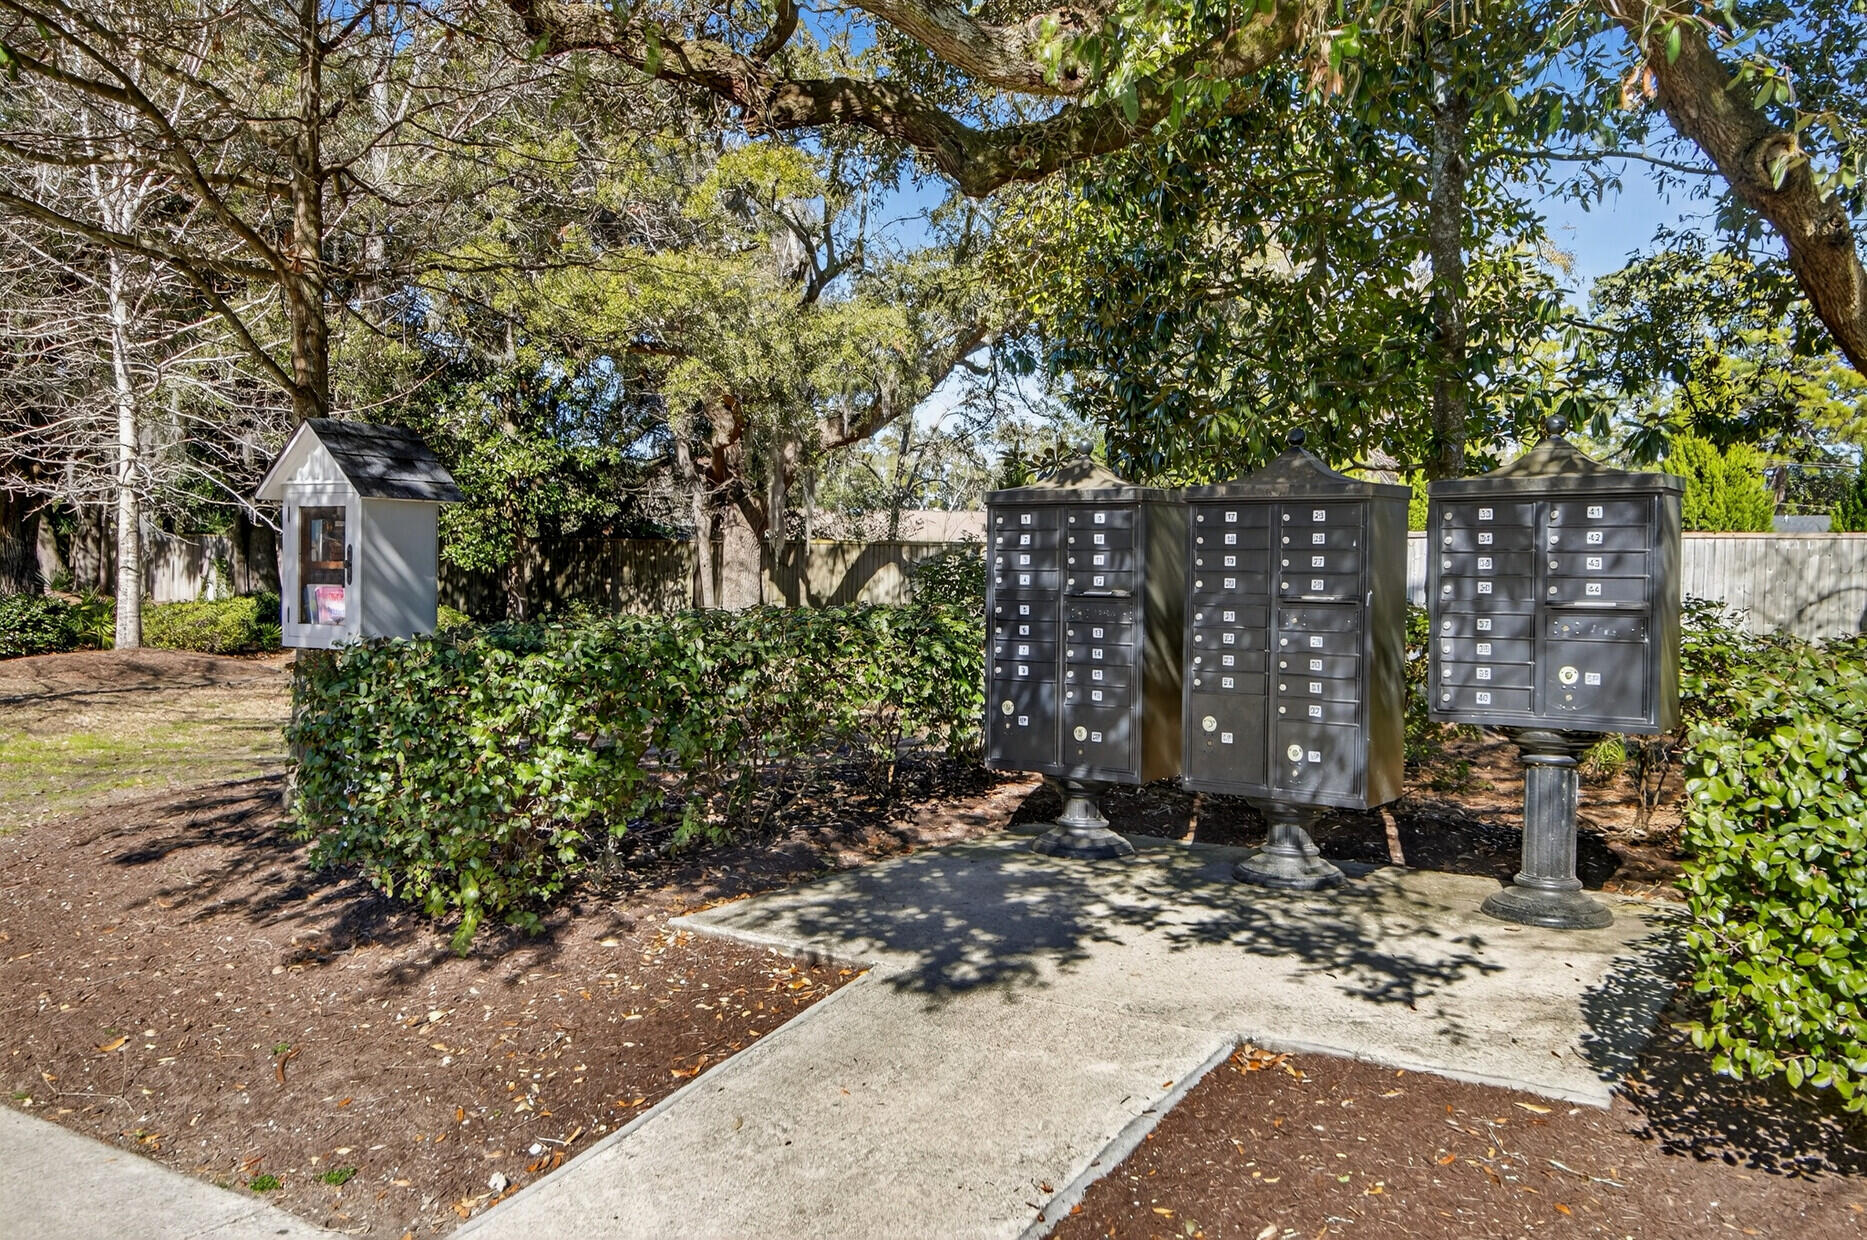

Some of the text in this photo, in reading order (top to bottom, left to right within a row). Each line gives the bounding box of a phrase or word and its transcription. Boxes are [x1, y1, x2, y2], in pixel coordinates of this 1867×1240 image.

[1227, 512, 1236, 521] 17
[1588, 507, 1600, 517] 41
[1587, 558, 1601, 568] 43
[1478, 620, 1490, 629] 37
[1477, 693, 1489, 703] 40
